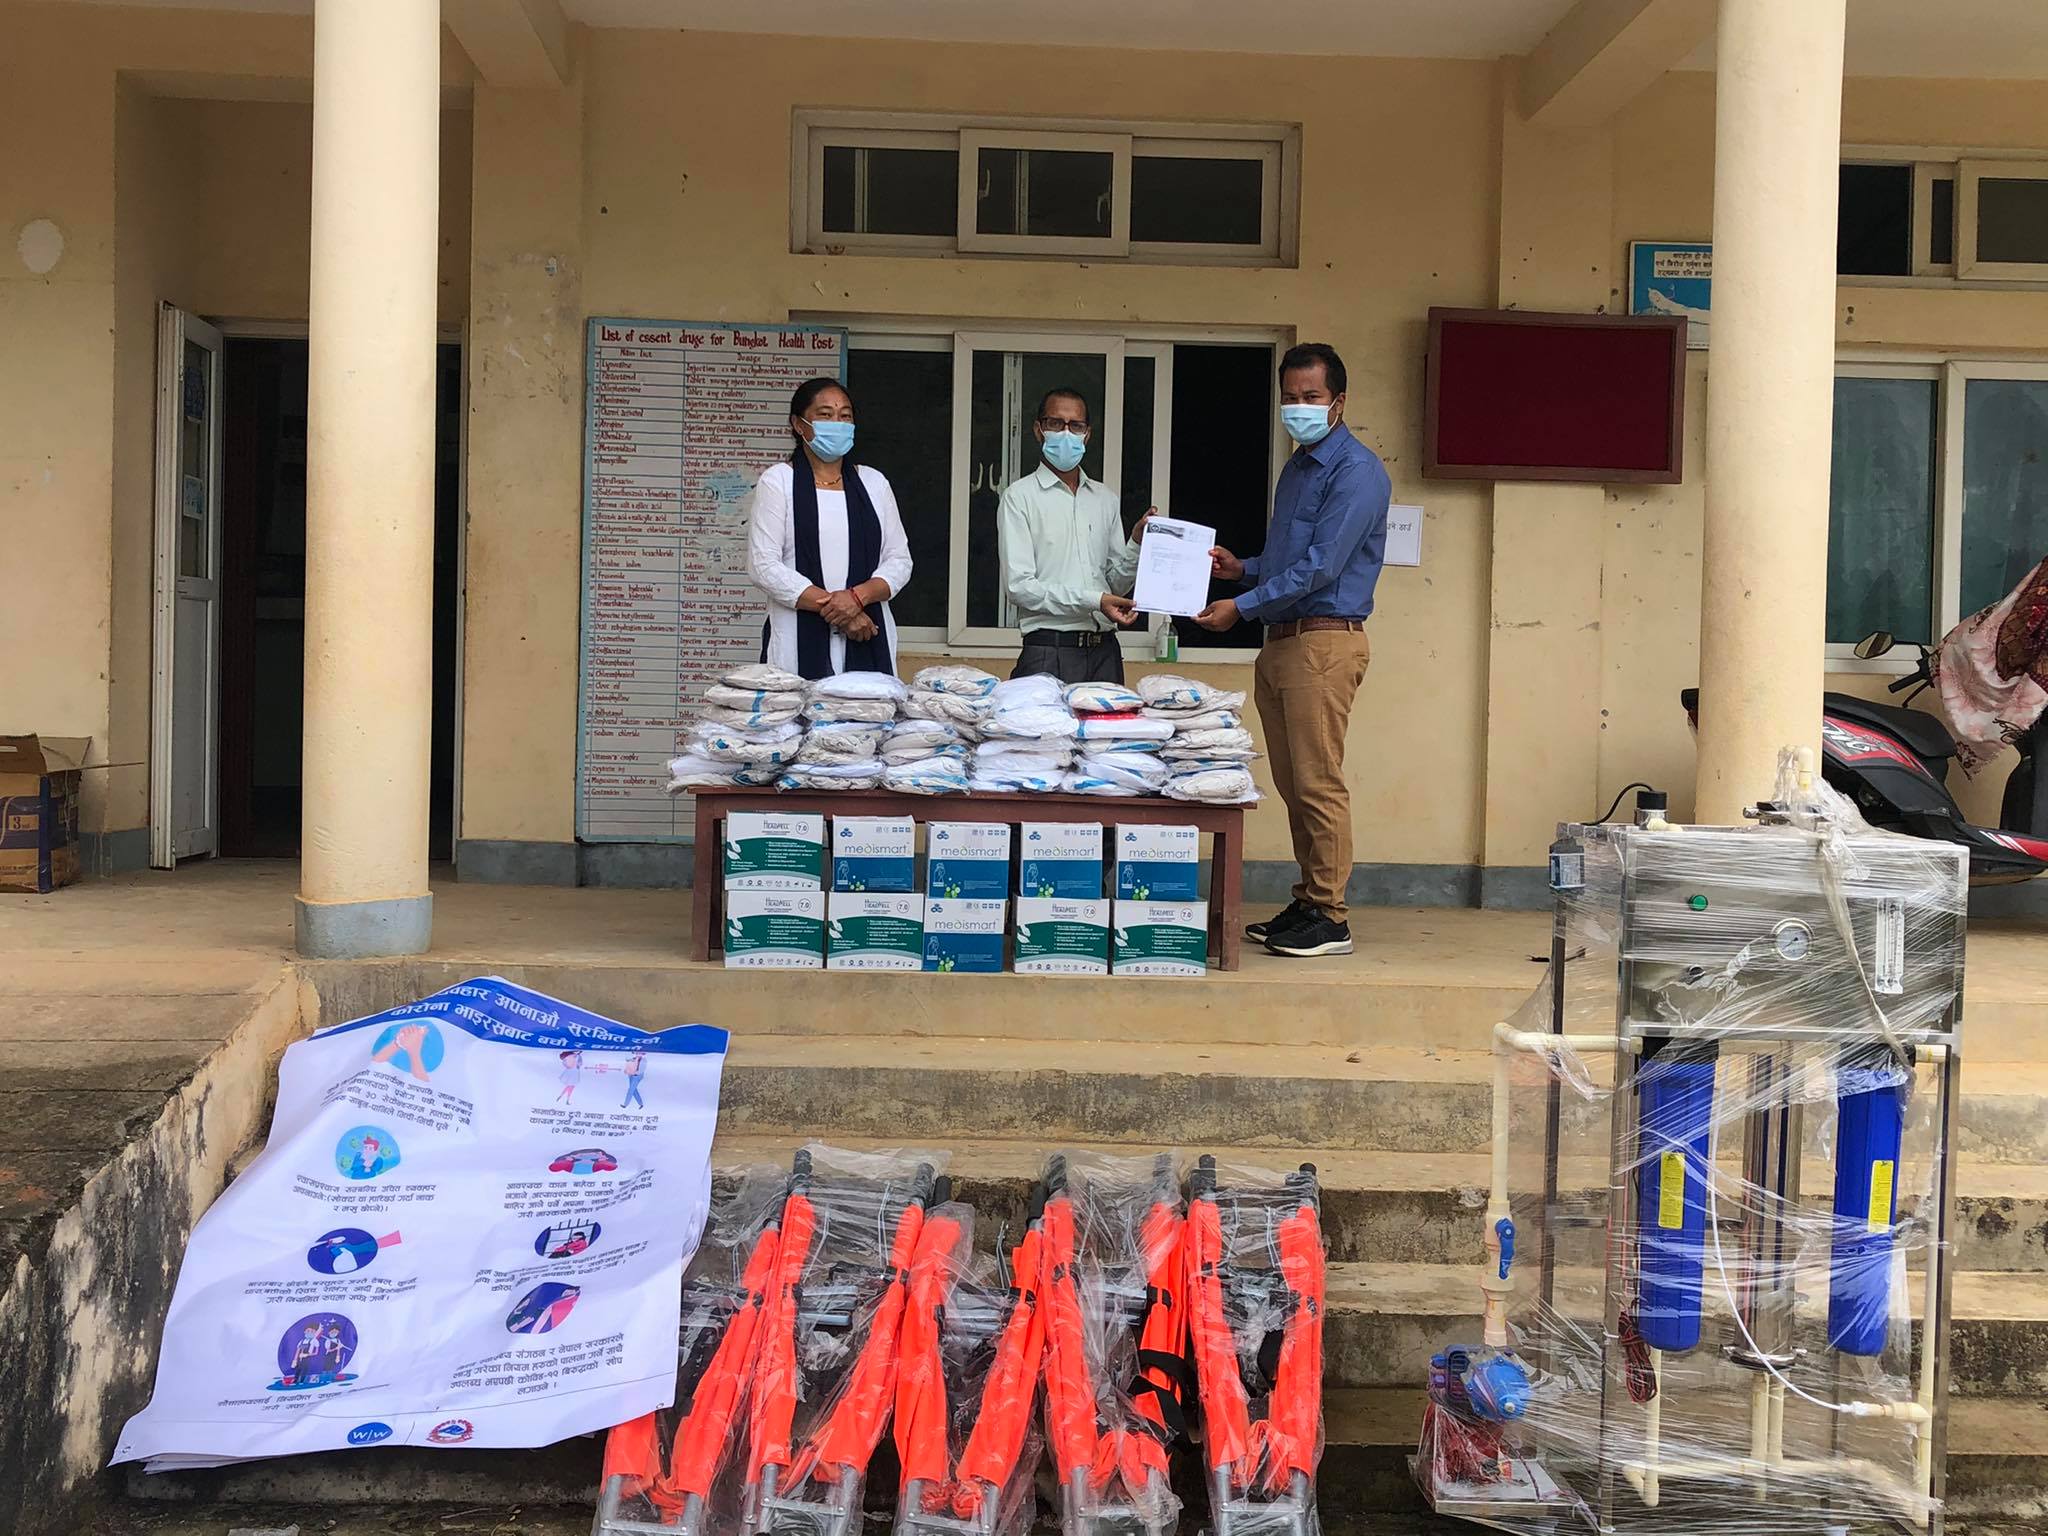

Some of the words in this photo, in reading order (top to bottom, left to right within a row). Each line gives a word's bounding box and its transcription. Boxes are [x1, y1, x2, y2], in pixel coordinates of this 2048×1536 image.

[602, 326, 621, 341] List
[625, 329, 635, 341] of
[710, 333, 725, 346] for
[779, 332, 805, 349] Health
[811, 333, 834, 349] Post
[845, 843, 907, 854] medismart
[941, 845, 1001, 856] medismart
[1033, 846, 1095, 857] medismart
[1129, 847, 1190, 859] medismart
[935, 917, 996, 930] medismart
